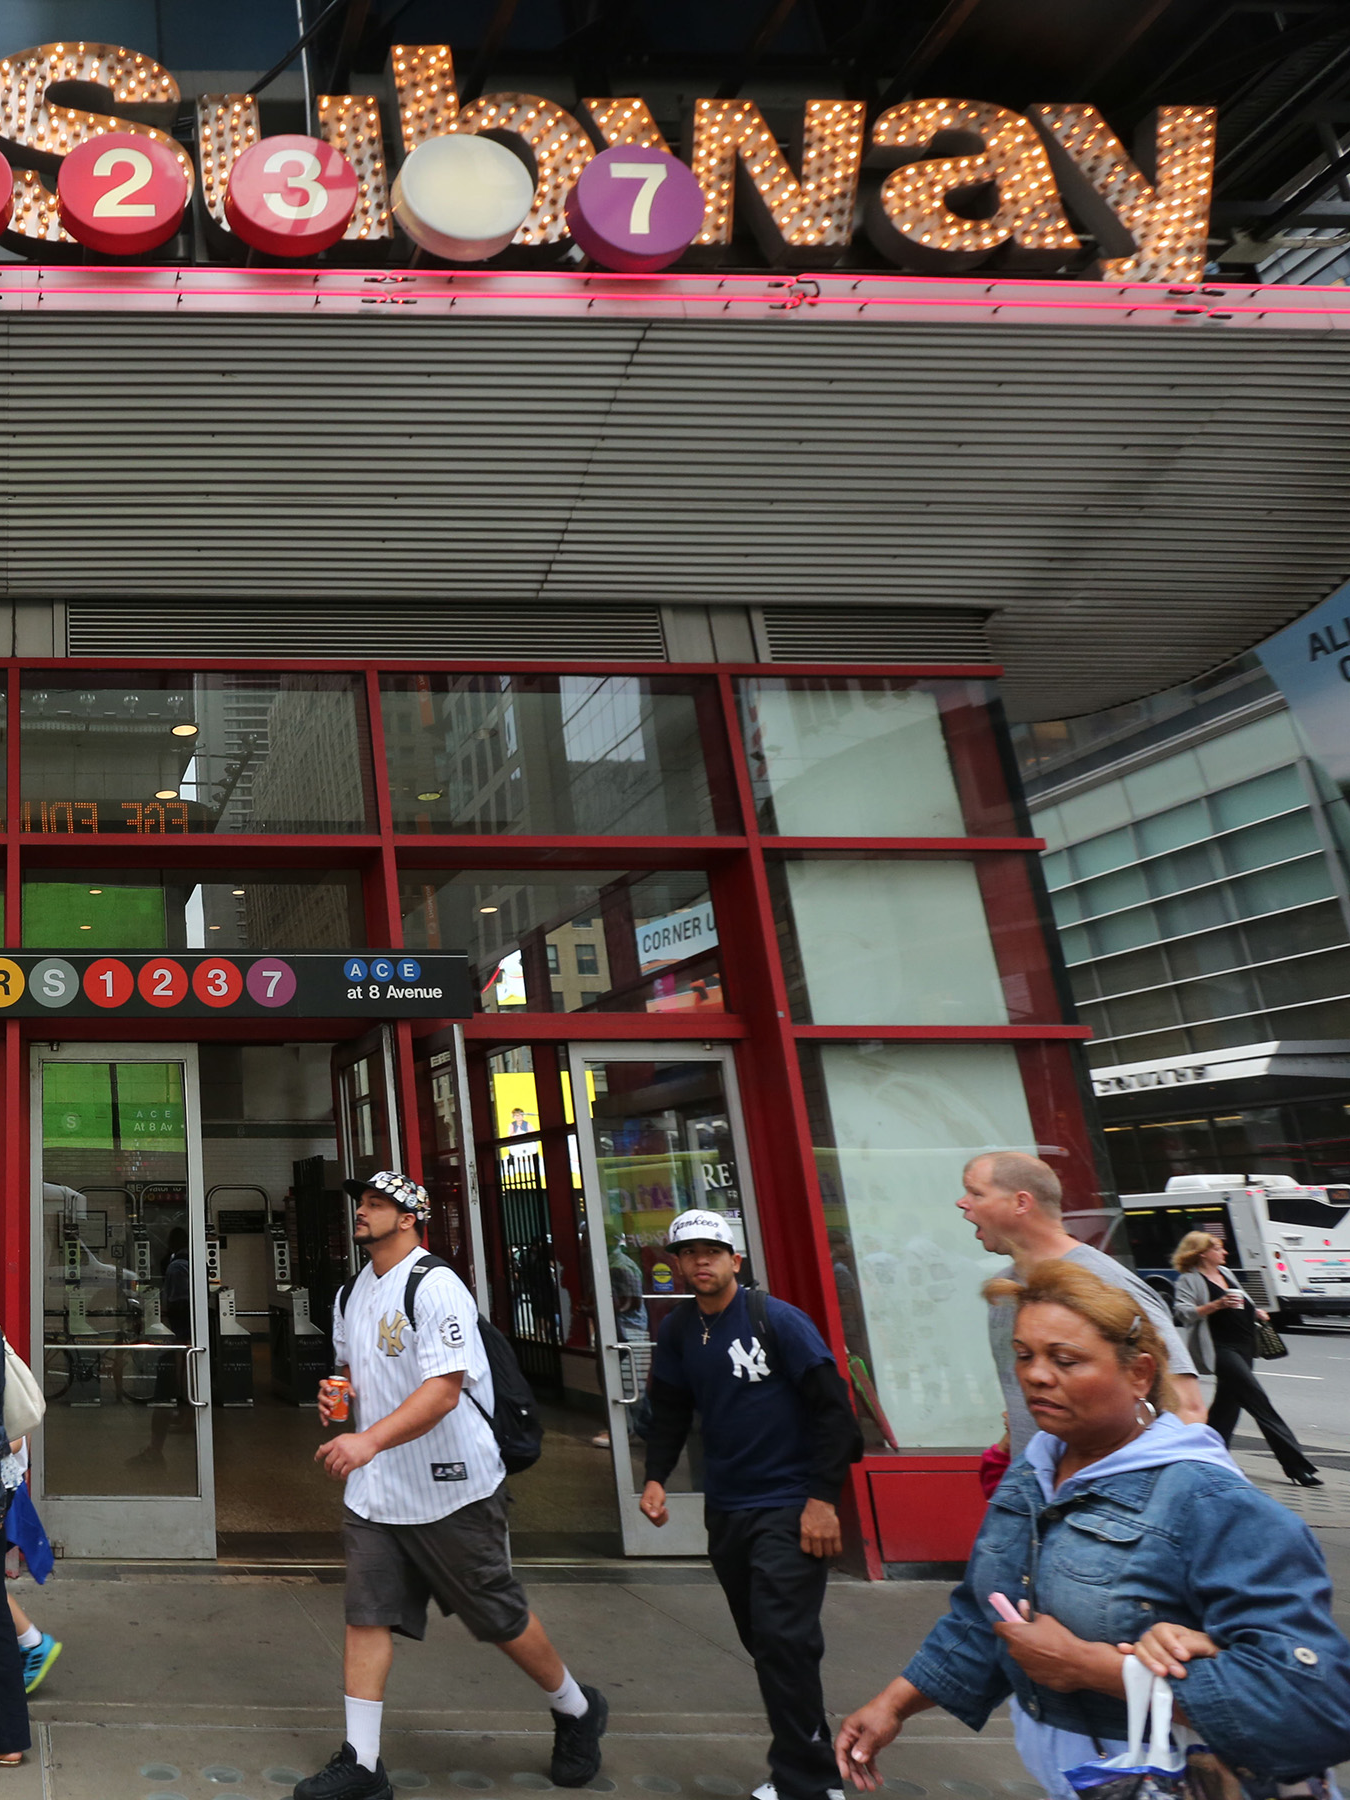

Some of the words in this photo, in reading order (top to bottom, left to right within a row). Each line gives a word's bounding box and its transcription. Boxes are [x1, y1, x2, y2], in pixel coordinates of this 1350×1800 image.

[91, 148, 156, 219] 2
[262, 149, 326, 219] 3
[608, 162, 669, 233] 7
[1309, 616, 1350, 662] AL
[642, 917, 702, 953] CORNER
[42, 969, 66, 998] S
[98, 970, 115, 998] 1
[150, 970, 176, 998] 2
[204, 970, 229, 998] 3
[260, 971, 282, 998] 7
[349, 964, 362, 977] A
[376, 964, 389, 977] C
[403, 964, 415, 977] E
[347, 986, 362, 999] at
[369, 986, 380, 999] 8
[386, 986, 443, 999] Avenue
[66, 1115, 76, 1128] S
[134, 1123, 145, 1131] At
[149, 1123, 155, 1131] 8
[160, 1123, 172, 1131] Av
[702, 1161, 734, 1192] RE
[673, 1215, 720, 1236] Yankees
[377, 1310, 409, 1357] NY
[448, 1323, 462, 1341] 2
[728, 1337, 771, 1382] NY
